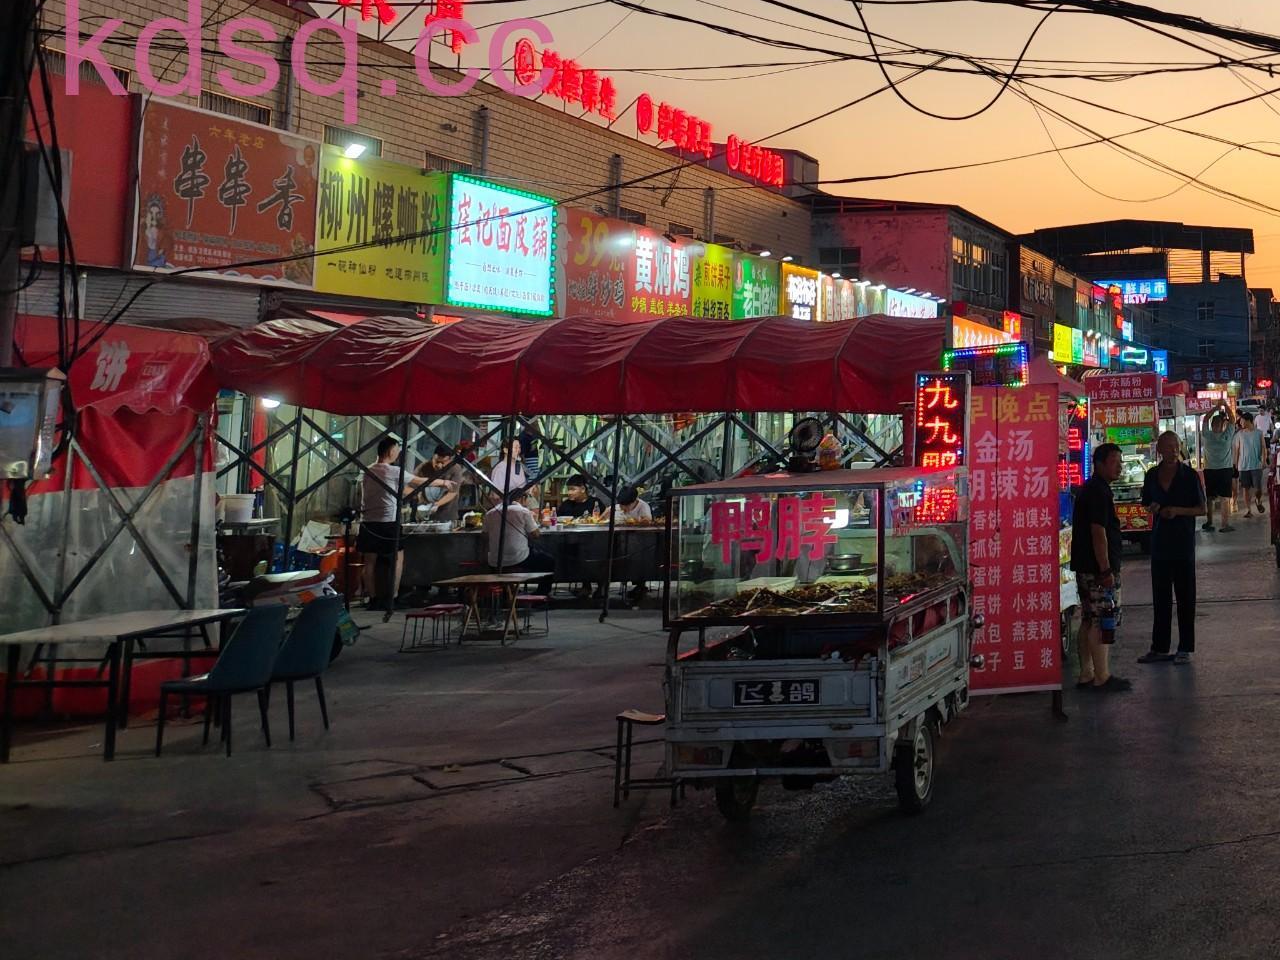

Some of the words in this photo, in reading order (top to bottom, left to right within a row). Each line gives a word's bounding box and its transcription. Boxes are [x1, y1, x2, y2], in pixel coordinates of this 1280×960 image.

[174, 134, 305, 235] 串串香
[318, 167, 441, 256] 柳州螺蛳粉
[573, 216, 626, 272] 39元
[634, 235, 690, 299] 黄焖鸡
[90, 340, 131, 392] 饼
[1098, 376, 1142, 389] 广东肠粉
[970, 392, 1053, 425] 早晚点
[1091, 405, 1140, 426] 广东肠粉
[974, 429, 1034, 464] 金汤
[711, 493, 838, 565] 鸭脖
[1012, 507, 1052, 530] 油馍头
[1012, 535, 1052, 557] 八宝粥
[1012, 563, 1052, 585] 绿豆粥
[1012, 591, 1052, 613] 小米粥
[1012, 620, 1053, 642] 燕麦粥
[737, 681, 816, 704] 飞鸽
